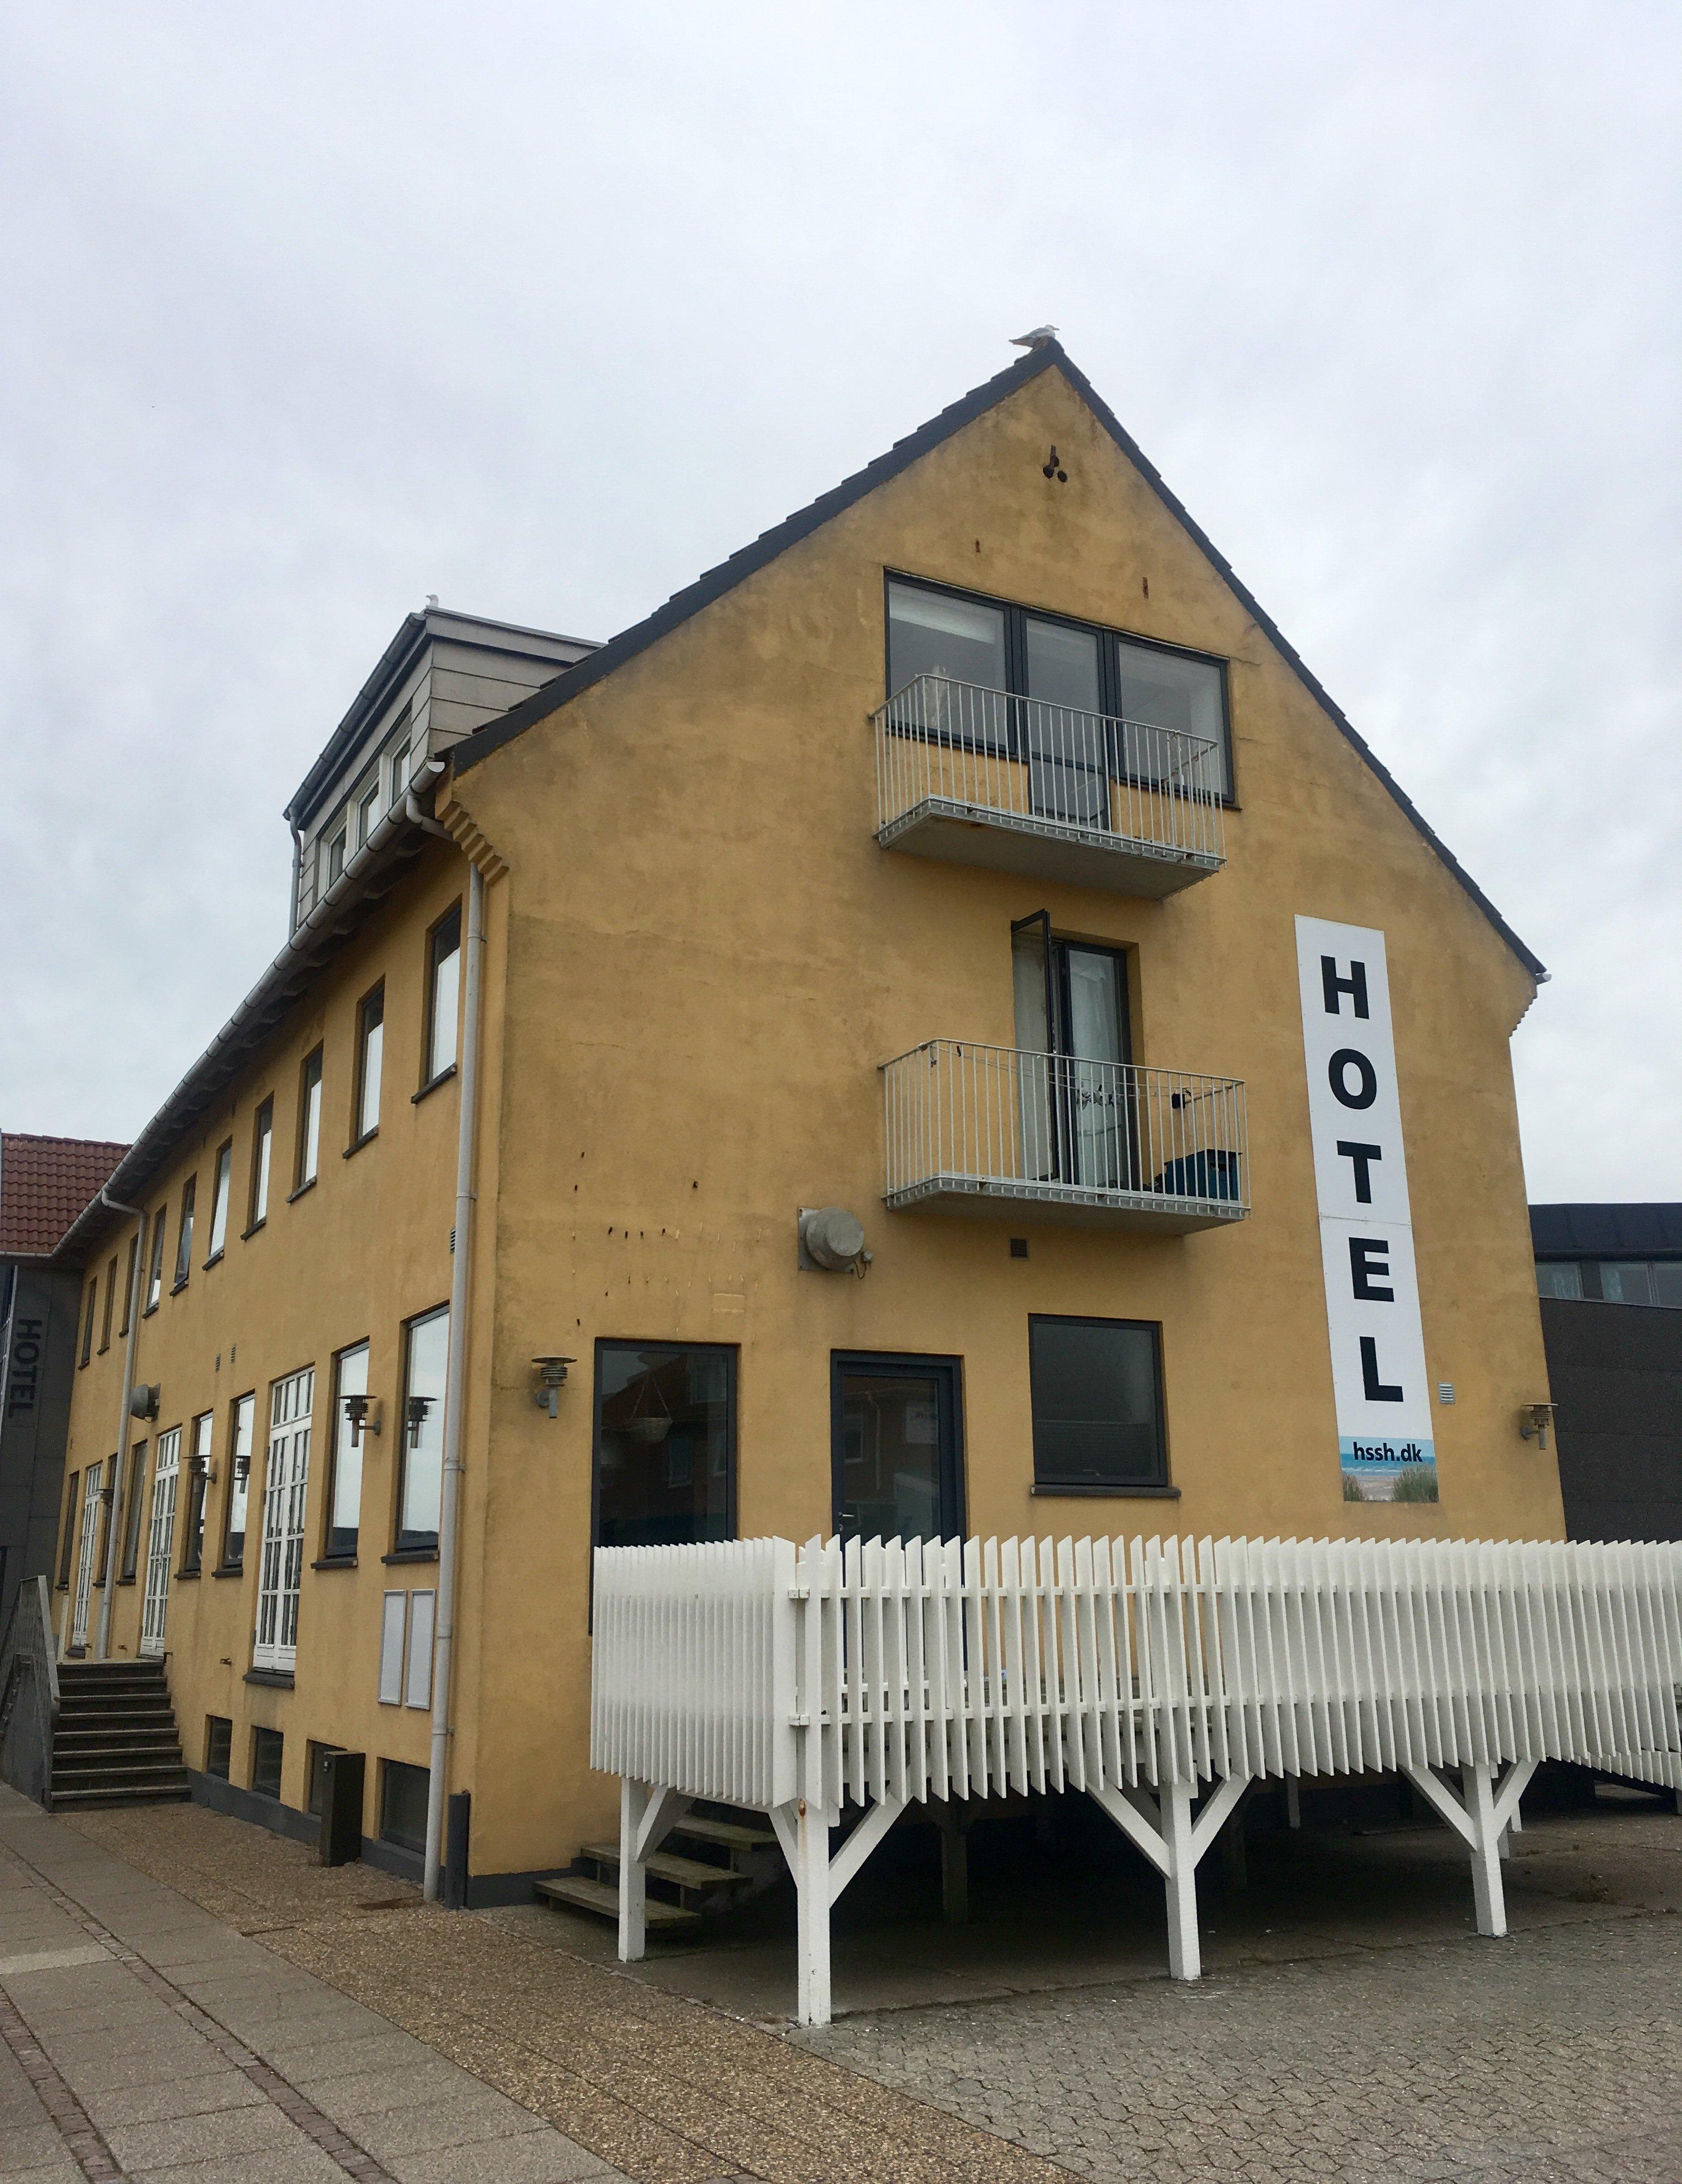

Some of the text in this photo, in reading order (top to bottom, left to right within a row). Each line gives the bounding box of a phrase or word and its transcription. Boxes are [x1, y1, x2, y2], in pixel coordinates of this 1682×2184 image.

[1320, 955, 1404, 1402] HOTEL
[8, 1319, 42, 1419] HOTEL
[1353, 1441, 1423, 1462] hssh.dk
